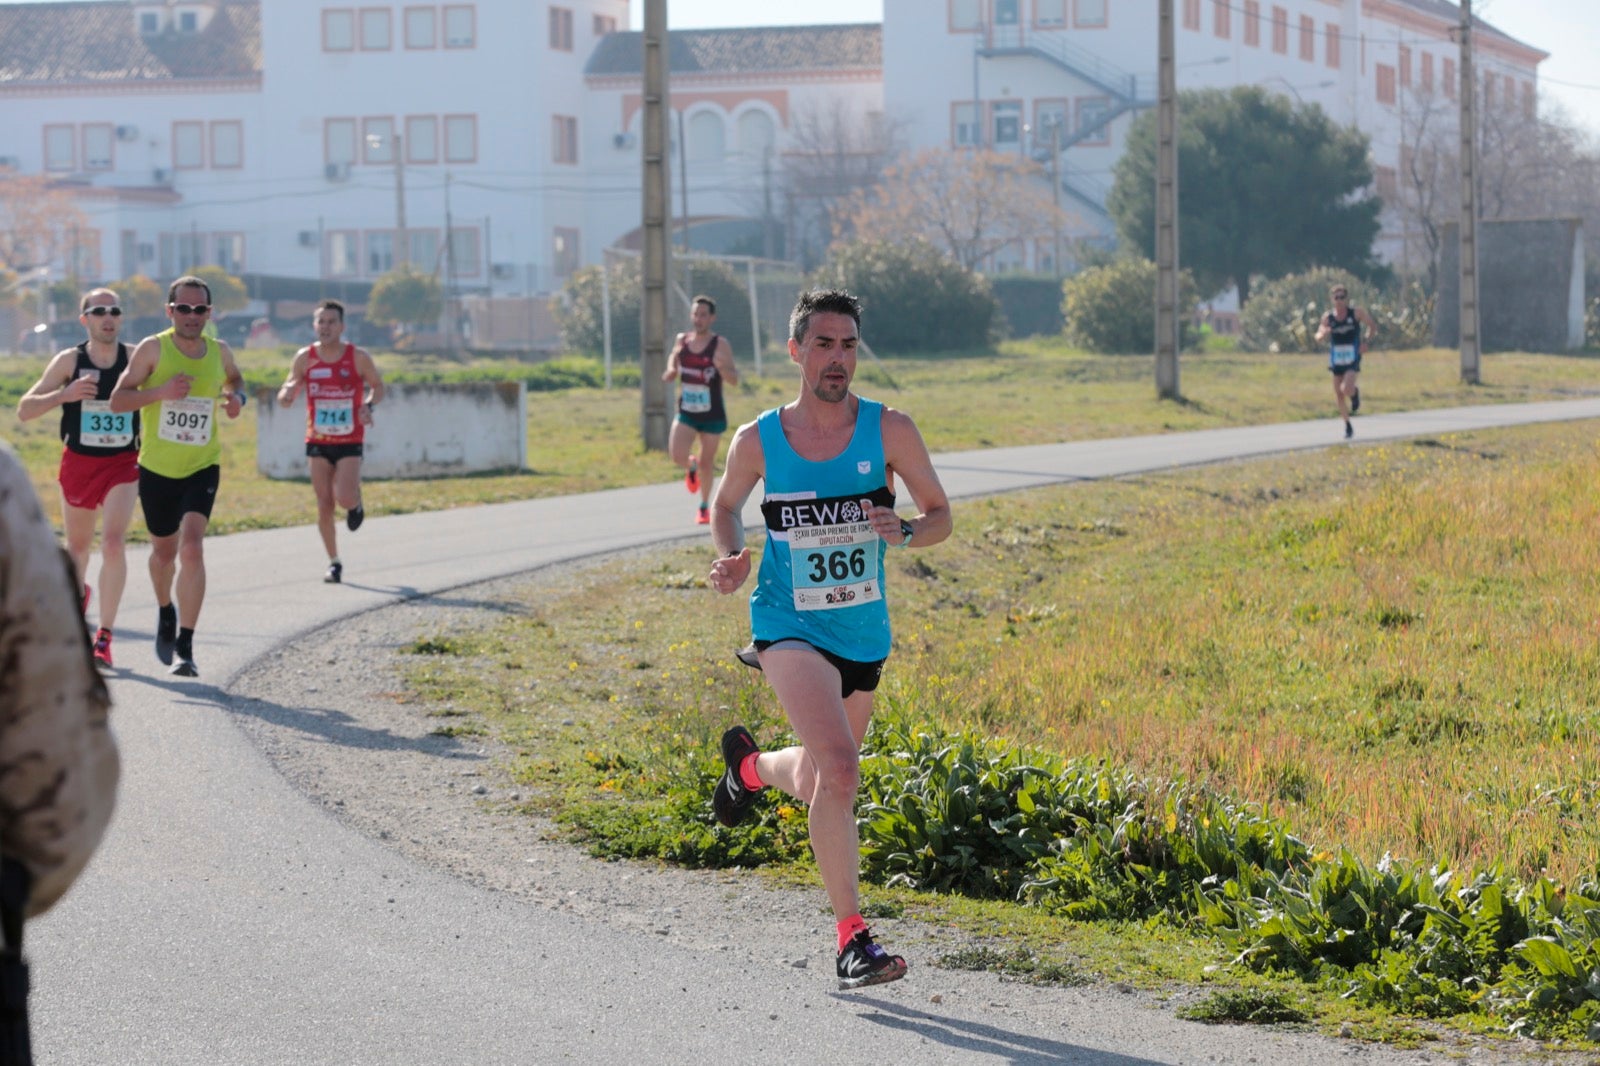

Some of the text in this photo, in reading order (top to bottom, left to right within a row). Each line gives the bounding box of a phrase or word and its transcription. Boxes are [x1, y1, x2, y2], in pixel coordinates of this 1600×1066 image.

[90, 414, 125, 432] 333
[166, 410, 209, 430] 3097
[320, 410, 347, 424] 714
[810, 528, 826, 538] GRAN
[828, 526, 849, 536] PREMIO
[850, 525, 857, 534] DE
[807, 548, 865, 583] 366
